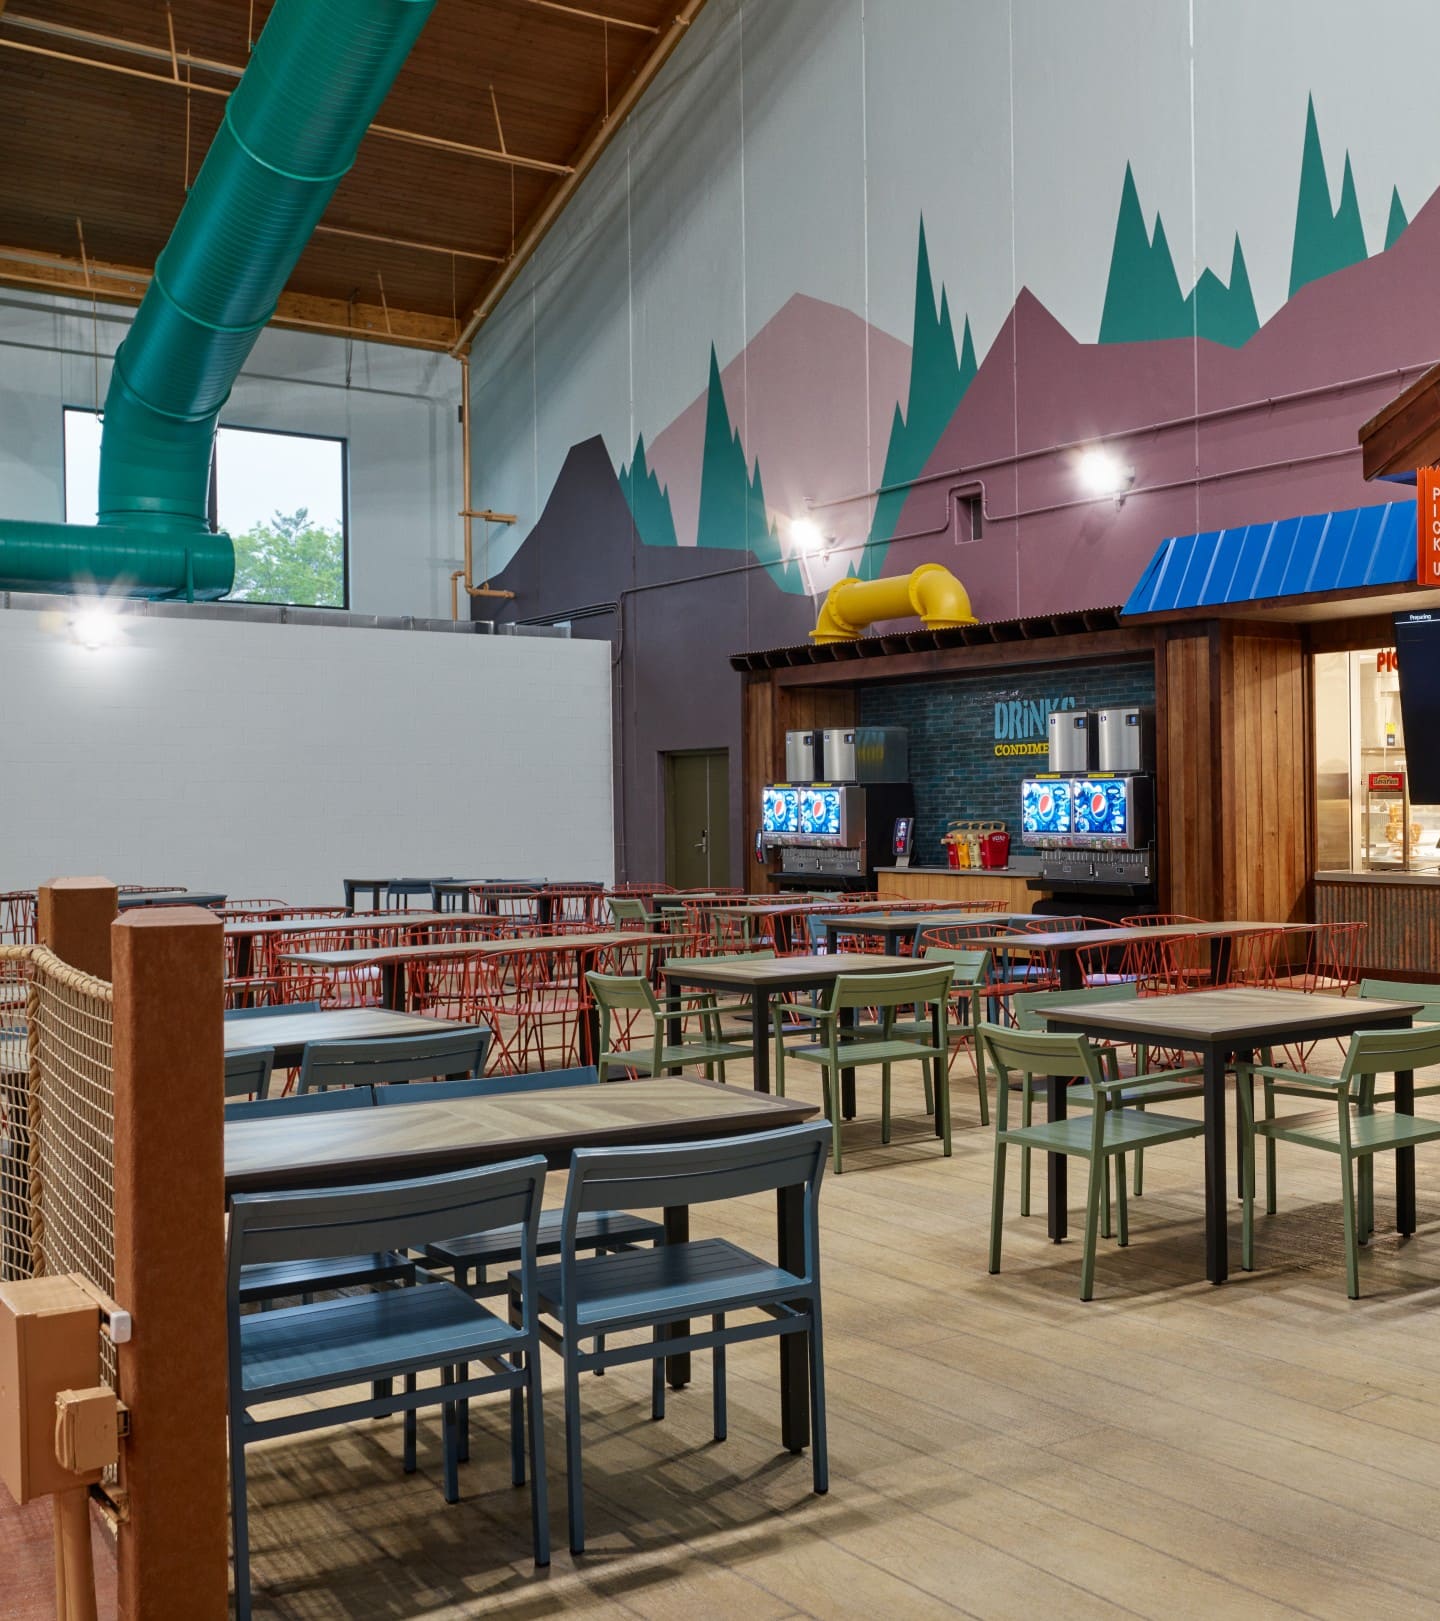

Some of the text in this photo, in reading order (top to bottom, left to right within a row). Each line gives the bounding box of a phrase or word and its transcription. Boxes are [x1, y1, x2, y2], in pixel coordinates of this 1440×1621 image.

[1432, 488, 1440, 551] PICK
[1377, 651, 1399, 672] PIC
[994, 697, 1076, 739] DRiN
[994, 742, 1049, 756] CONDIME
